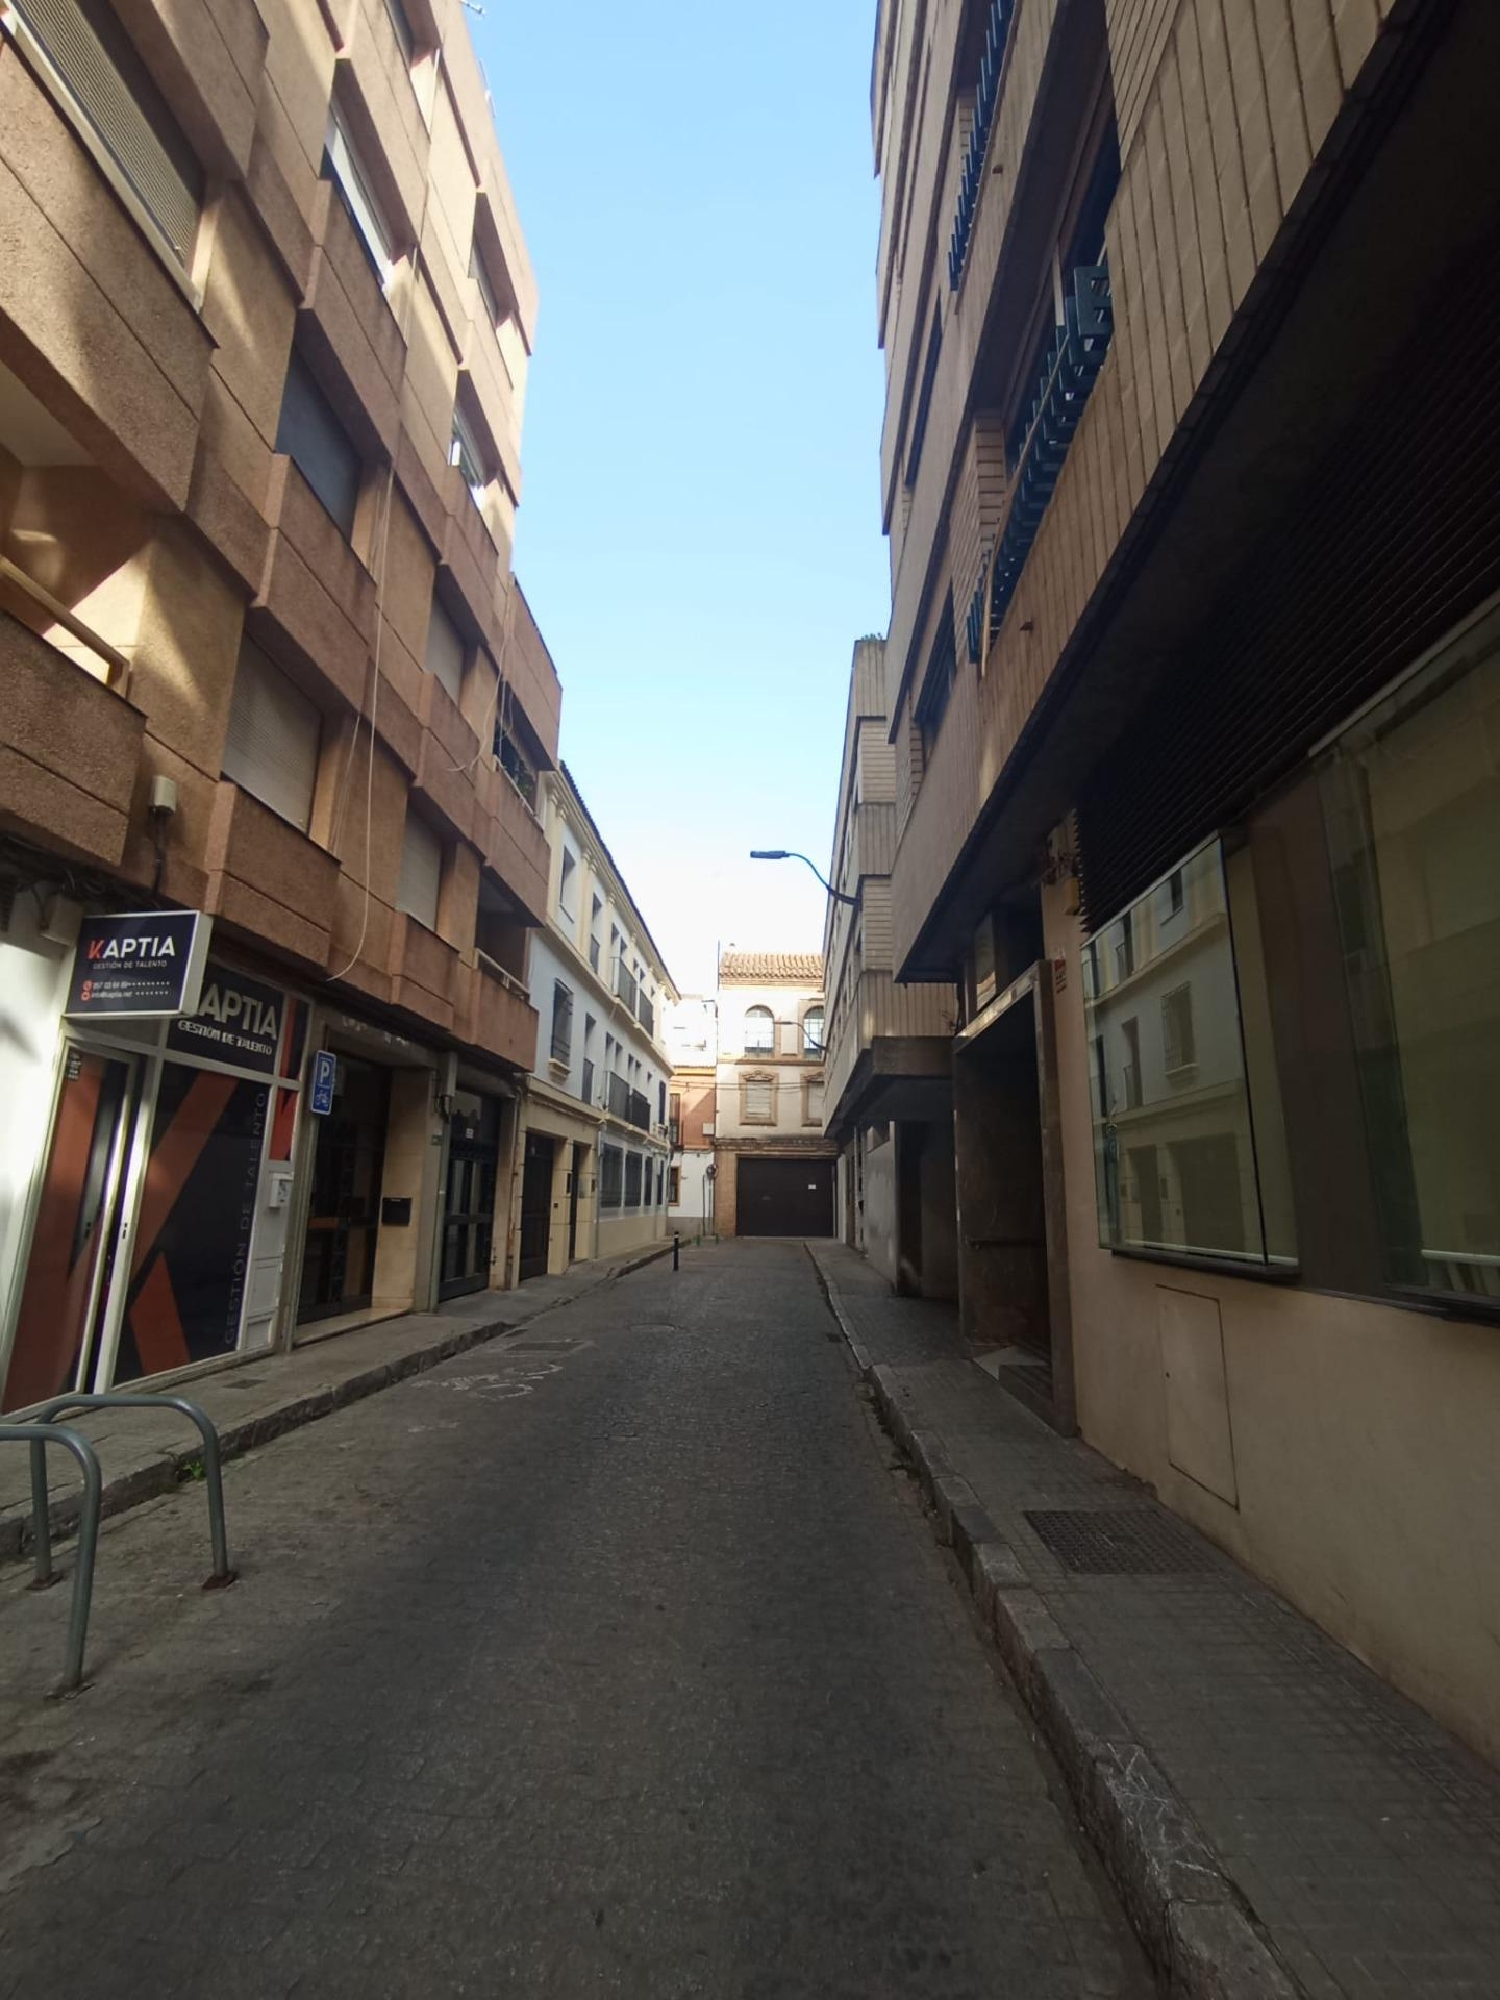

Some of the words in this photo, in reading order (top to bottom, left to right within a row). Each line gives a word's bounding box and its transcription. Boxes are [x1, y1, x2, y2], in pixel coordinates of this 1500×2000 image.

[88, 936, 176, 959] KAPTIA
[123, 960, 133, 969] DE
[198, 982, 277, 1041] APTIA
[221, 1032, 235, 1046] DE
[320, 1060, 330, 1083] P
[240, 1204, 252, 1230] DE
[246, 1093, 266, 1187] TALENTO
